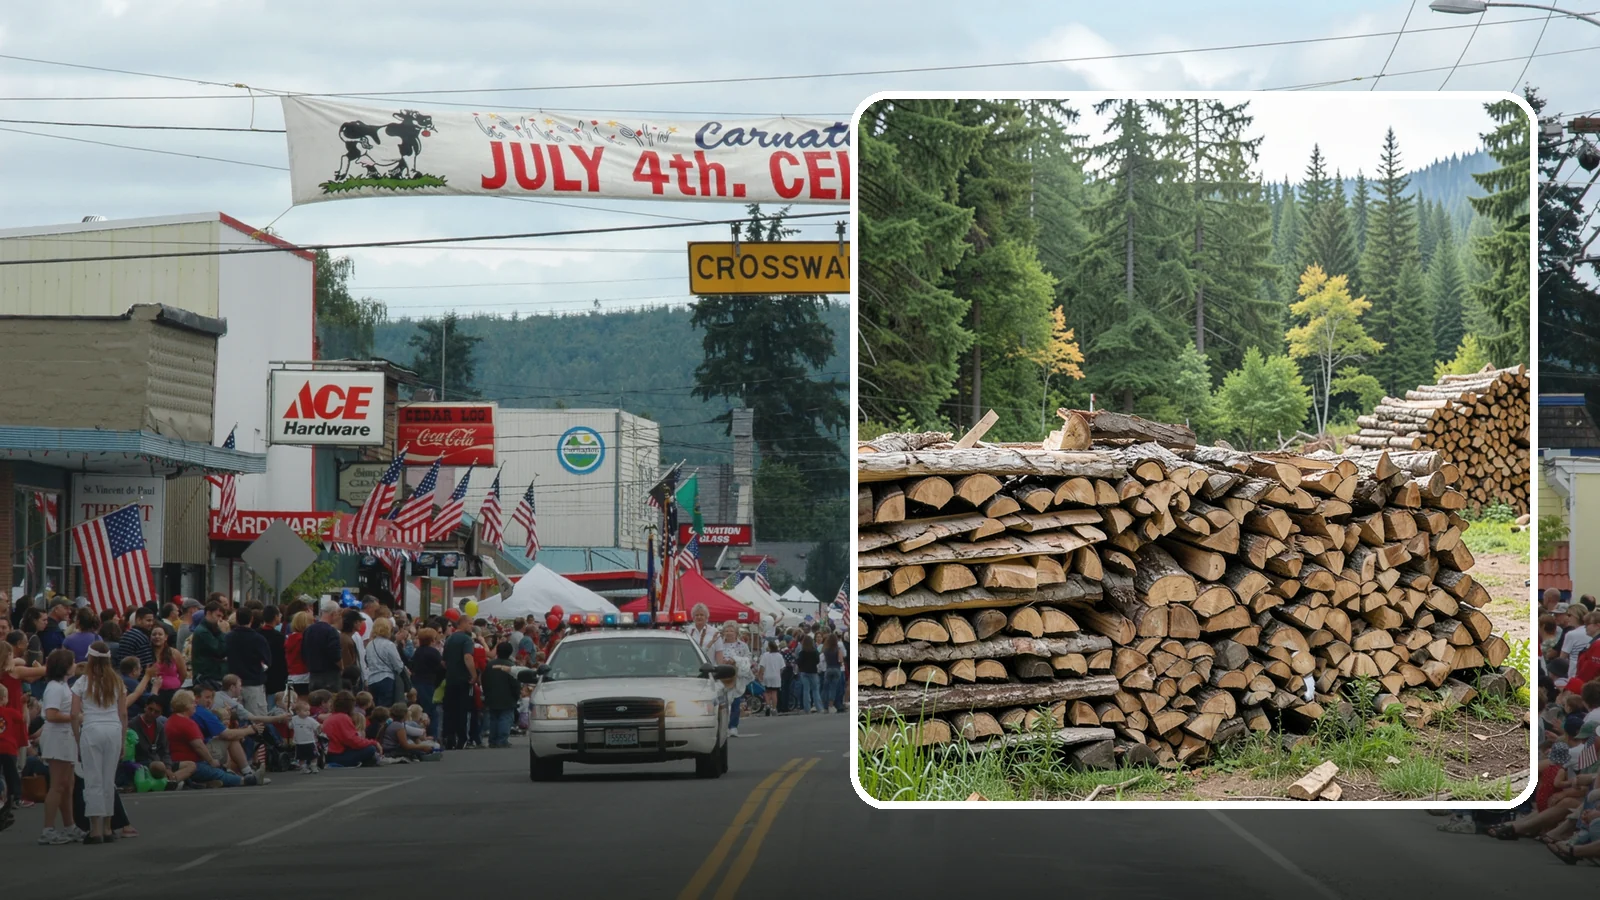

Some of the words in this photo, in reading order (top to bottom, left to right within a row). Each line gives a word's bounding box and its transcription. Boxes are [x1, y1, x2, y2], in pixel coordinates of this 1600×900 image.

[481, 141, 605, 193] JULY
[632, 149, 746, 197] 4th.
[697, 254, 850, 280] CROSSWA
[283, 380, 373, 420] ACE
[405, 409, 452, 422] CEDAR
[283, 421, 371, 437] Hardware
[353, 467, 386, 481] Simpl
[83, 485, 93, 494] St.
[95, 485, 124, 494] Vincent
[126, 485, 136, 494] de
[137, 486, 155, 495] Paul
[212, 516, 330, 535] HARDARE
[688, 526, 741, 535] CRNATION
[699, 535, 730, 543] GLASS
